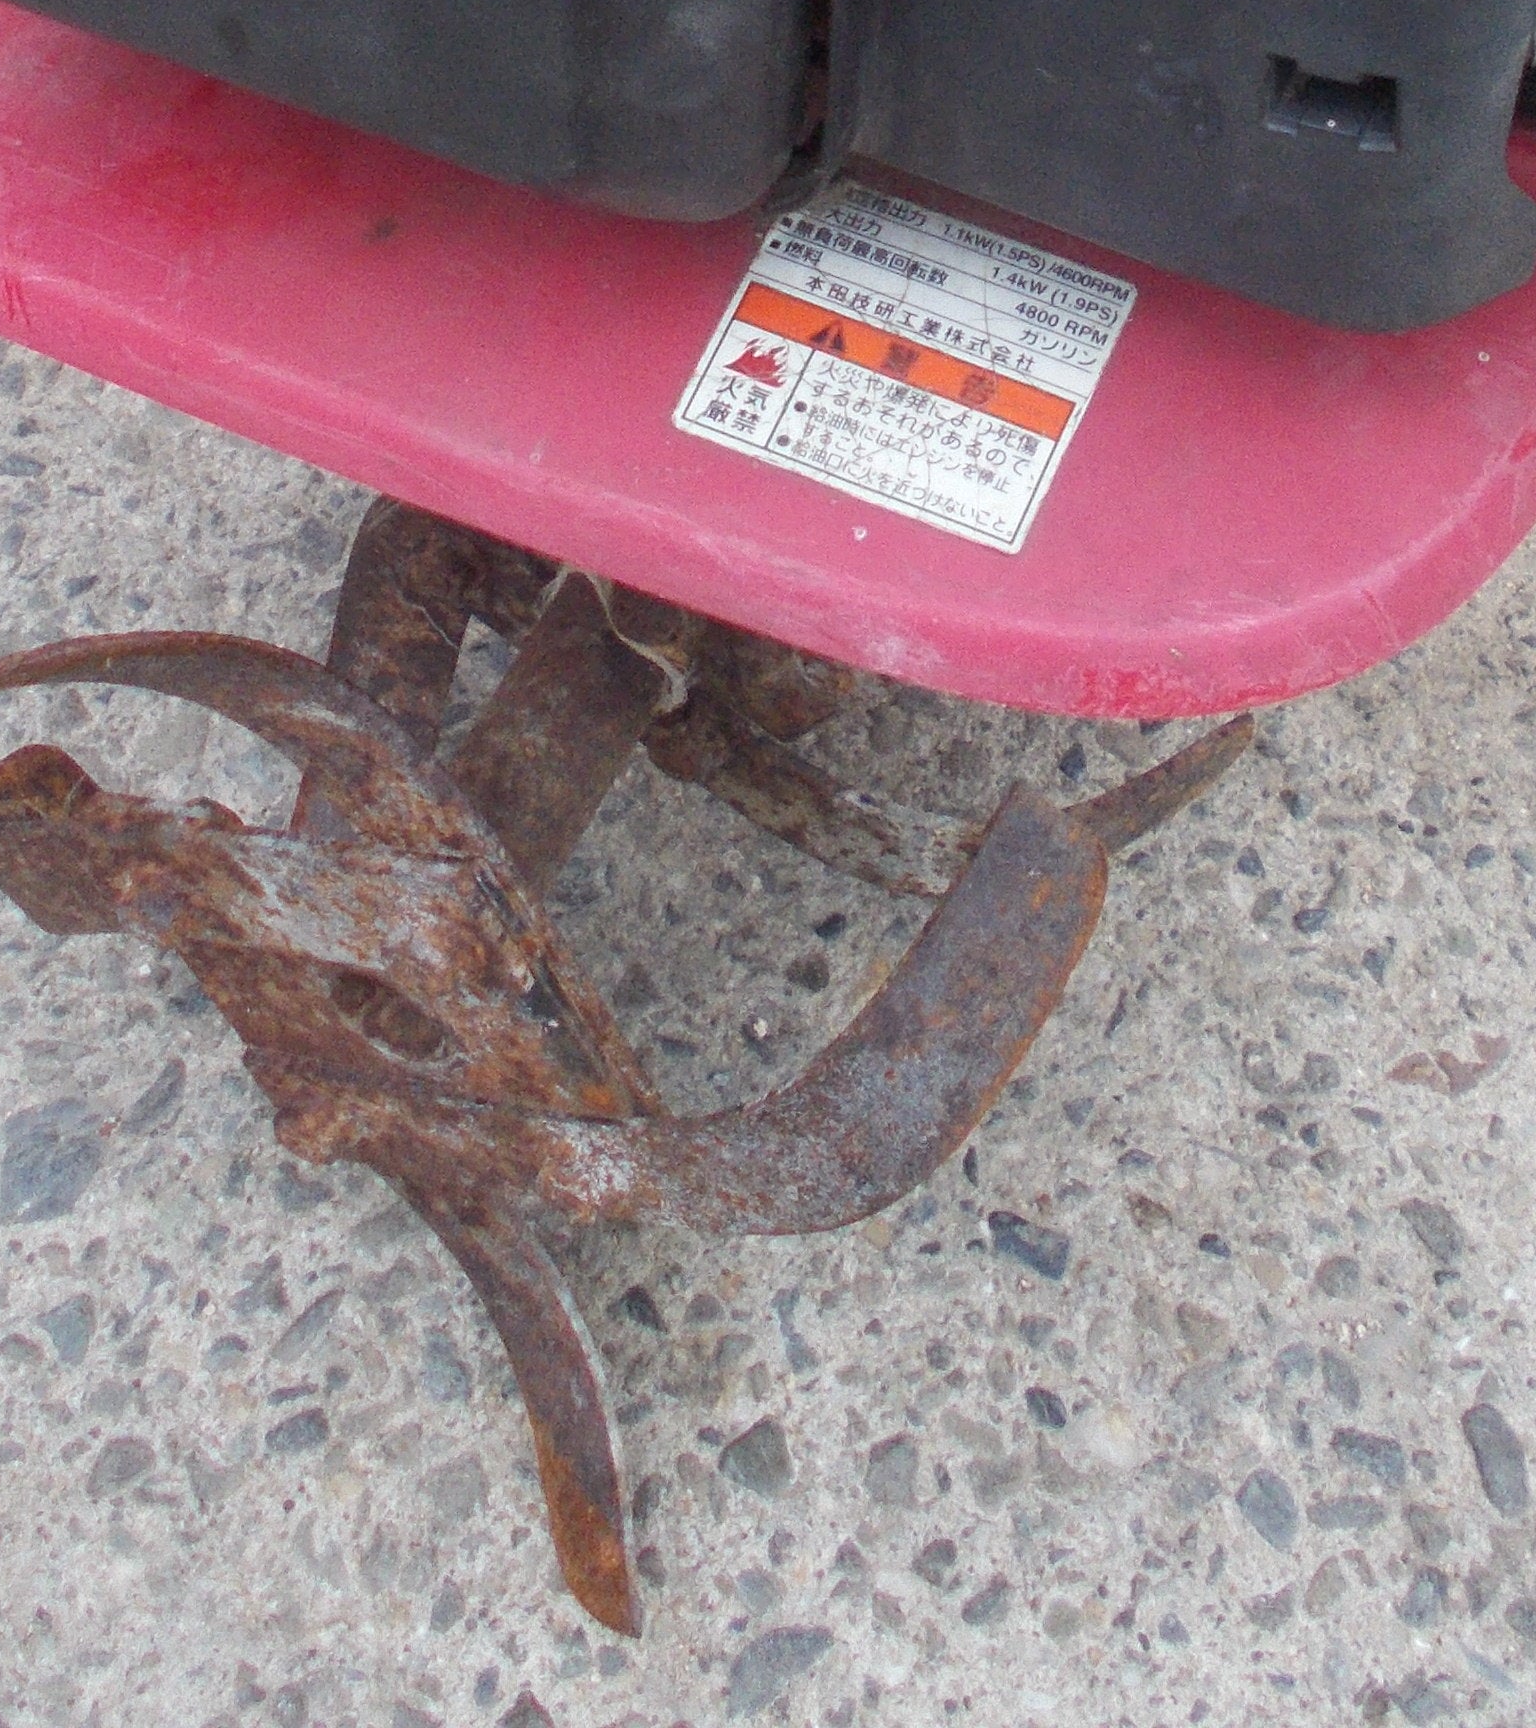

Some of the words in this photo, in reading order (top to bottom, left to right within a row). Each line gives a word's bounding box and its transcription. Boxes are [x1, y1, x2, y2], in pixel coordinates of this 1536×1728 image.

[992, 266, 1048, 295] 1.4kW
[1050, 288, 1119, 325] (1.9PS)
[806, 275, 1036, 372] 本田技研工業株式会社
[1015, 302, 1060, 327] 4800
[1064, 320, 1110, 347] RPM
[1018, 328, 1098, 366] ガソリン
[716, 375, 773, 411] 火気
[819, 360, 1042, 457] 火災や爆発により死傷
